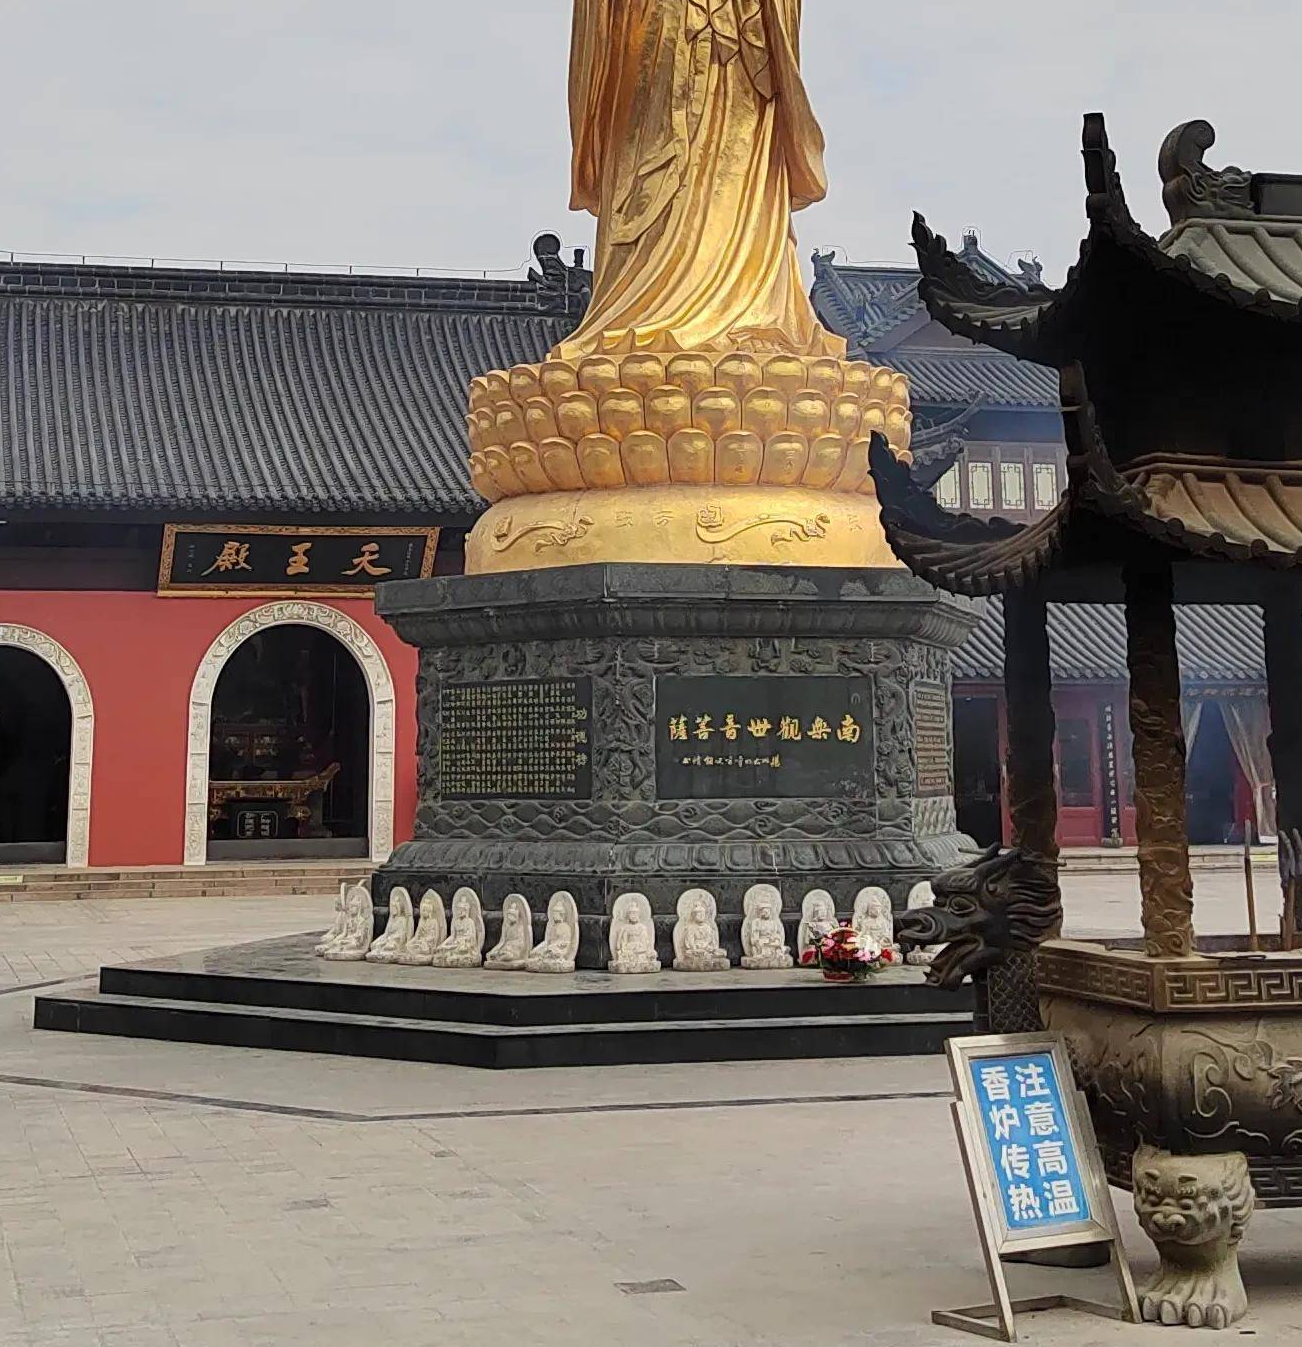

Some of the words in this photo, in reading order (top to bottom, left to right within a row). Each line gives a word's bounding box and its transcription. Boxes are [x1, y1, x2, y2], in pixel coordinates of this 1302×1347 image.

[200, 540, 392, 577] 天王殿
[980, 1065, 1043, 1221] 香炉传热
[1014, 1062, 1079, 1217] 注意高温
